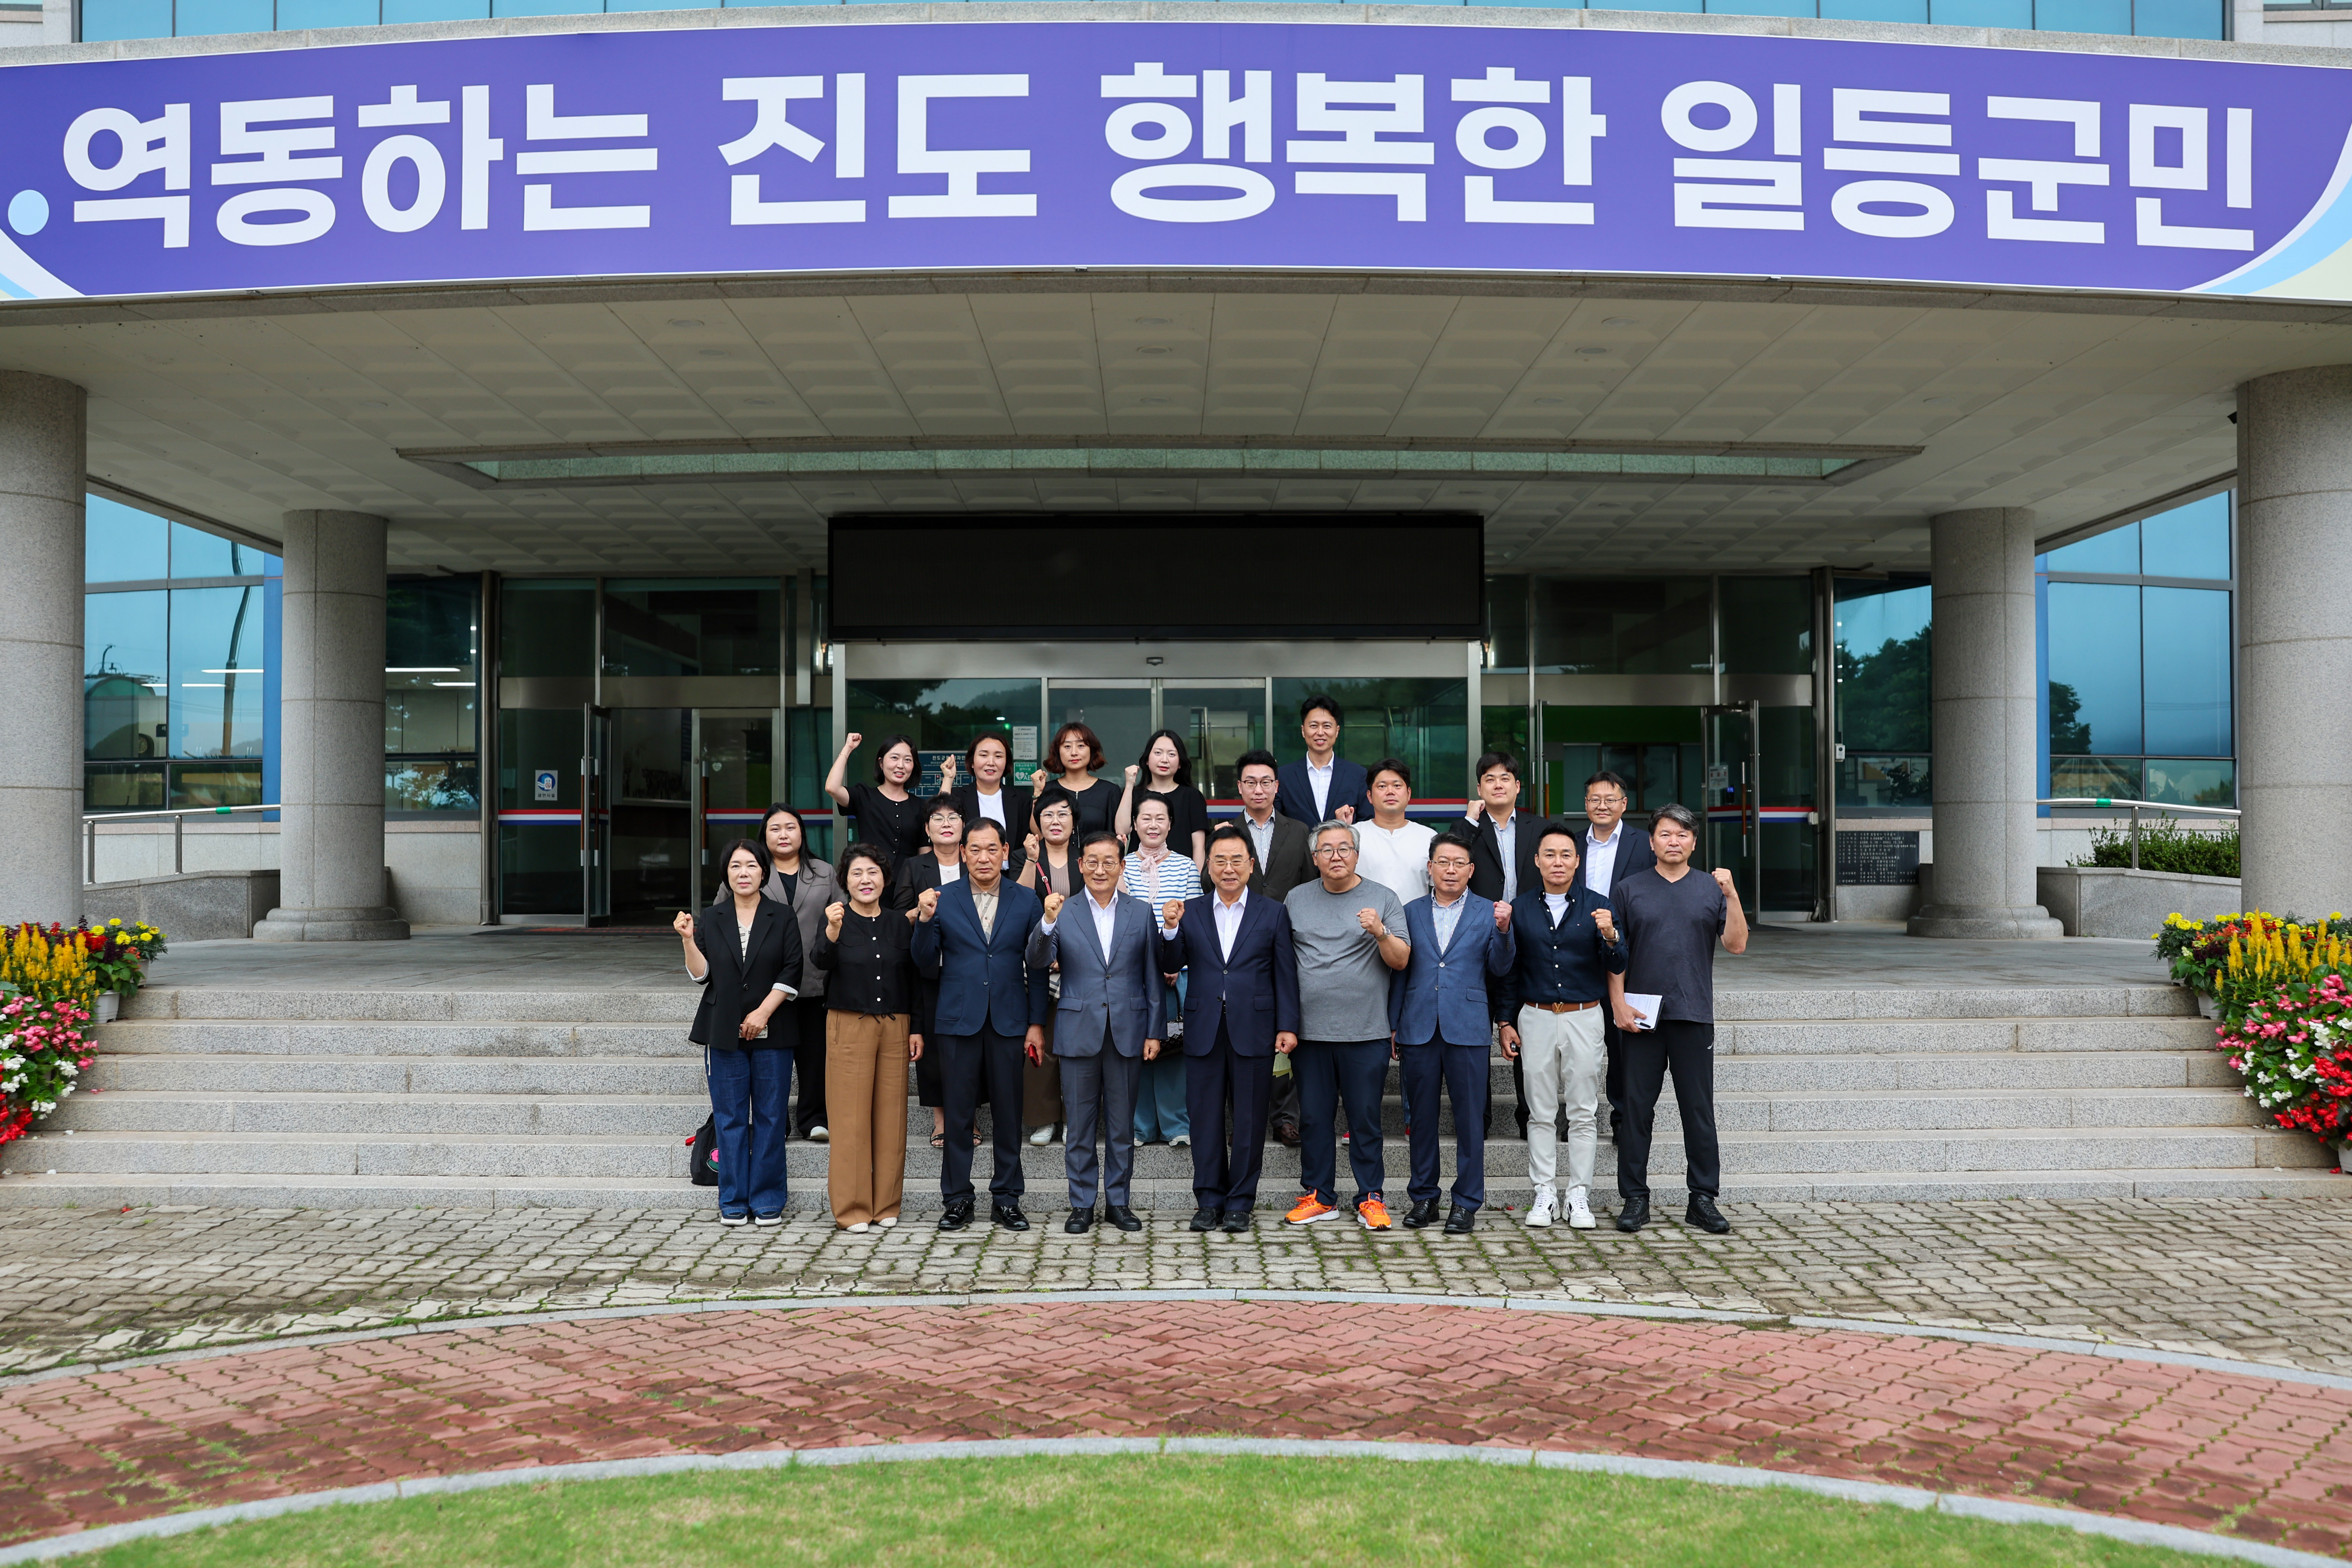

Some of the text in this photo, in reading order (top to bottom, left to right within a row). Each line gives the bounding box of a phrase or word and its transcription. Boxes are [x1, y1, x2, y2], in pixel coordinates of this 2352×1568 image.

[64, 62, 2254, 251] 역동하는 진도 행복한 일등군민
